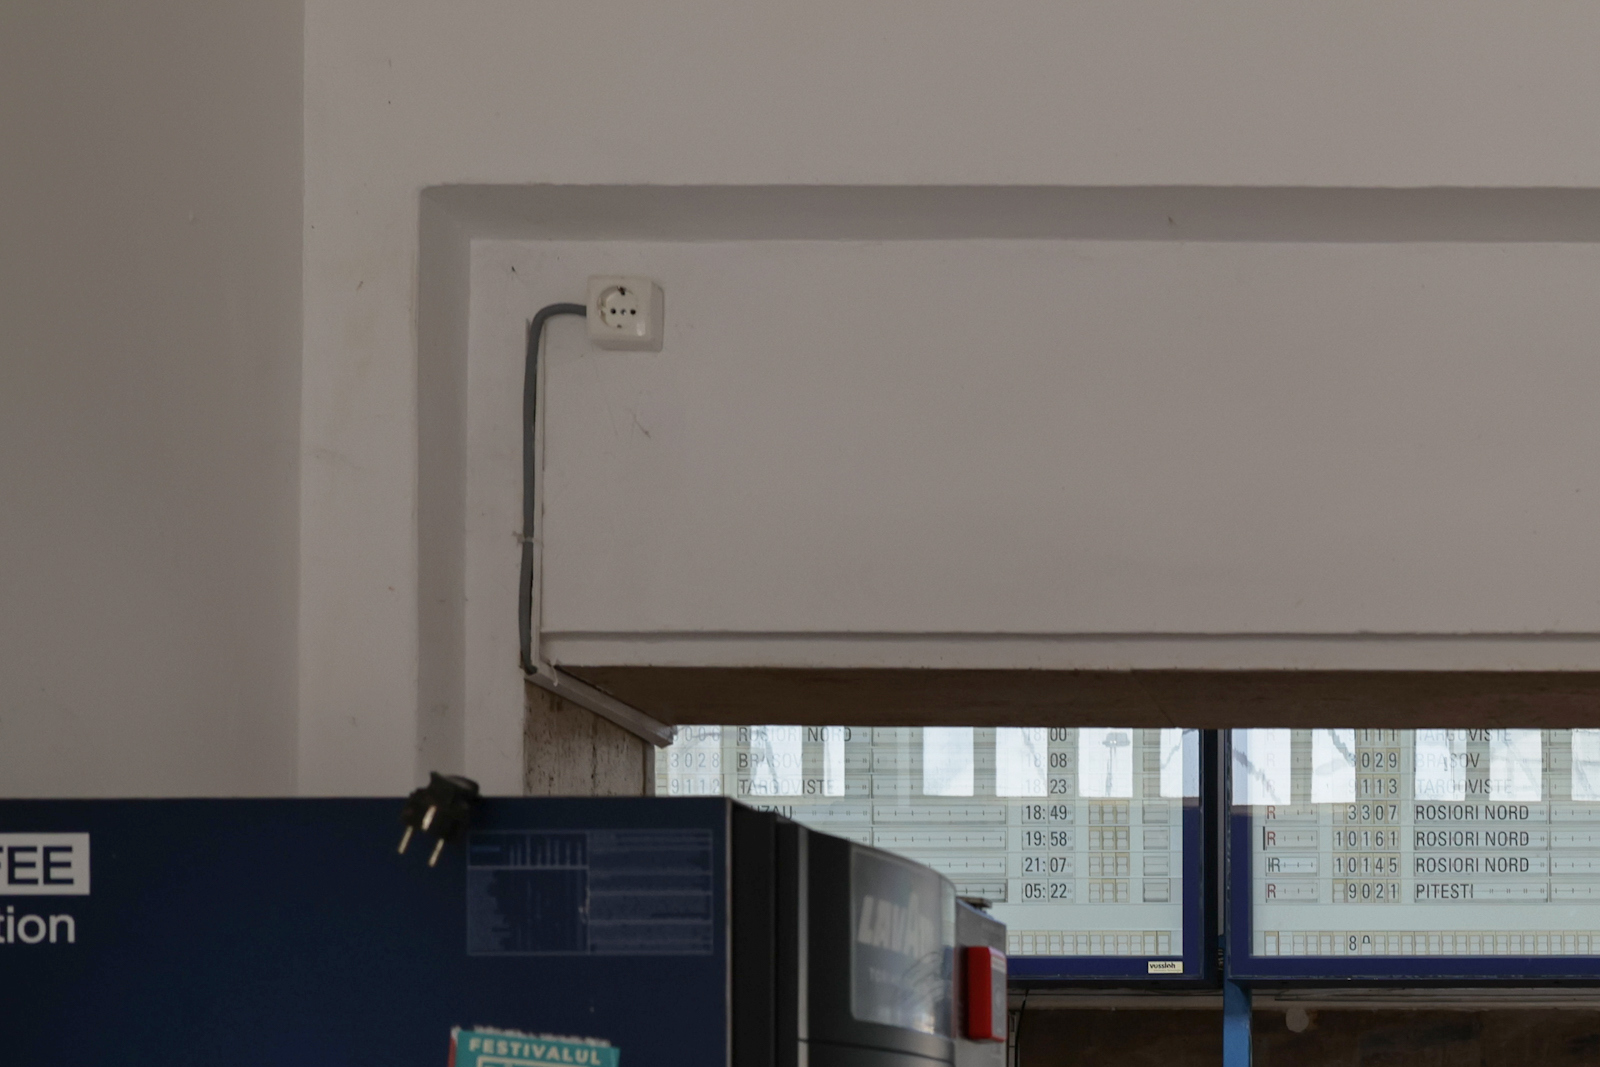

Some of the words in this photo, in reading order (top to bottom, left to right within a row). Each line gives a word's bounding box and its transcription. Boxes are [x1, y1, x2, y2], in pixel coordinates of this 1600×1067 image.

[807, 726, 852, 742] NORD
[670, 752, 720, 768] 3028
[738, 752, 802, 768] BRASOV
[1416, 753, 1480, 768] BRASOV
[671, 779, 720, 795] 9112
[738, 779, 836, 795] TARGOVISTE
[1025, 805, 1067, 820] 18:49
[1266, 805, 1276, 820] R
[1348, 805, 1397, 820] 3307
[1415, 805, 1479, 820] ROSIORI
[1485, 805, 1529, 820] NORD
[1025, 831, 1067, 847] 19:58
[1266, 831, 1276, 846] R
[1336, 831, 1397, 846] 10161
[1415, 831, 1479, 846] ROSIORI
[1485, 831, 1529, 846] NORD
[0, 846, 74, 885] EE
[1024, 857, 1067, 873] 21:07
[1336, 857, 1397, 872] 10145
[1415, 857, 1479, 872] ROSIORI
[1485, 857, 1529, 872] NORD
[1024, 883, 1067, 899] 05:22
[1266, 884, 1276, 899] R
[1348, 884, 1397, 899] 9021
[1415, 883, 1474, 899] PITESTI
[469, 1038, 602, 1066] FESTIVALUL
